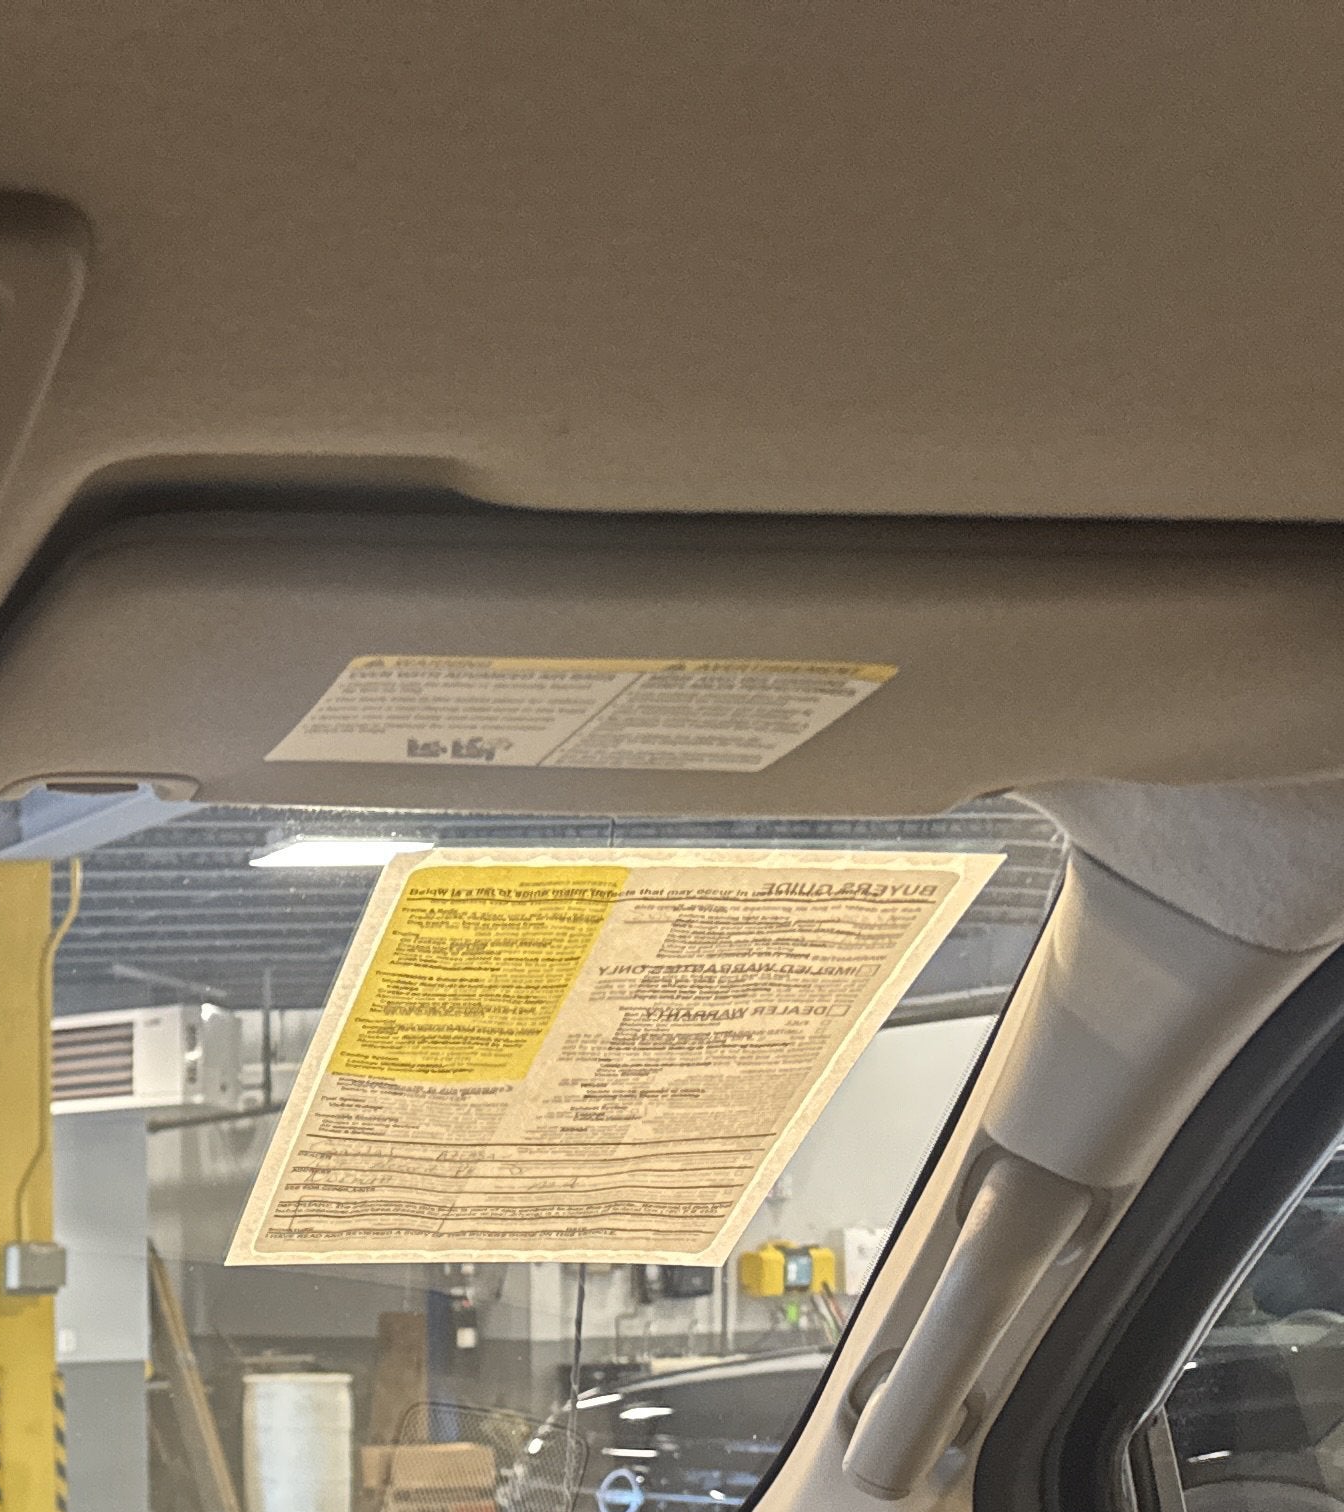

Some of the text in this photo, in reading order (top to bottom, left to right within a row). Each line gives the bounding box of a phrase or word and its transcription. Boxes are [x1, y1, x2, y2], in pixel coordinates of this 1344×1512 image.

[639, 887, 664, 897] that
[667, 888, 694, 899] may
[696, 888, 734, 897] occur
[736, 888, 749, 897] in
